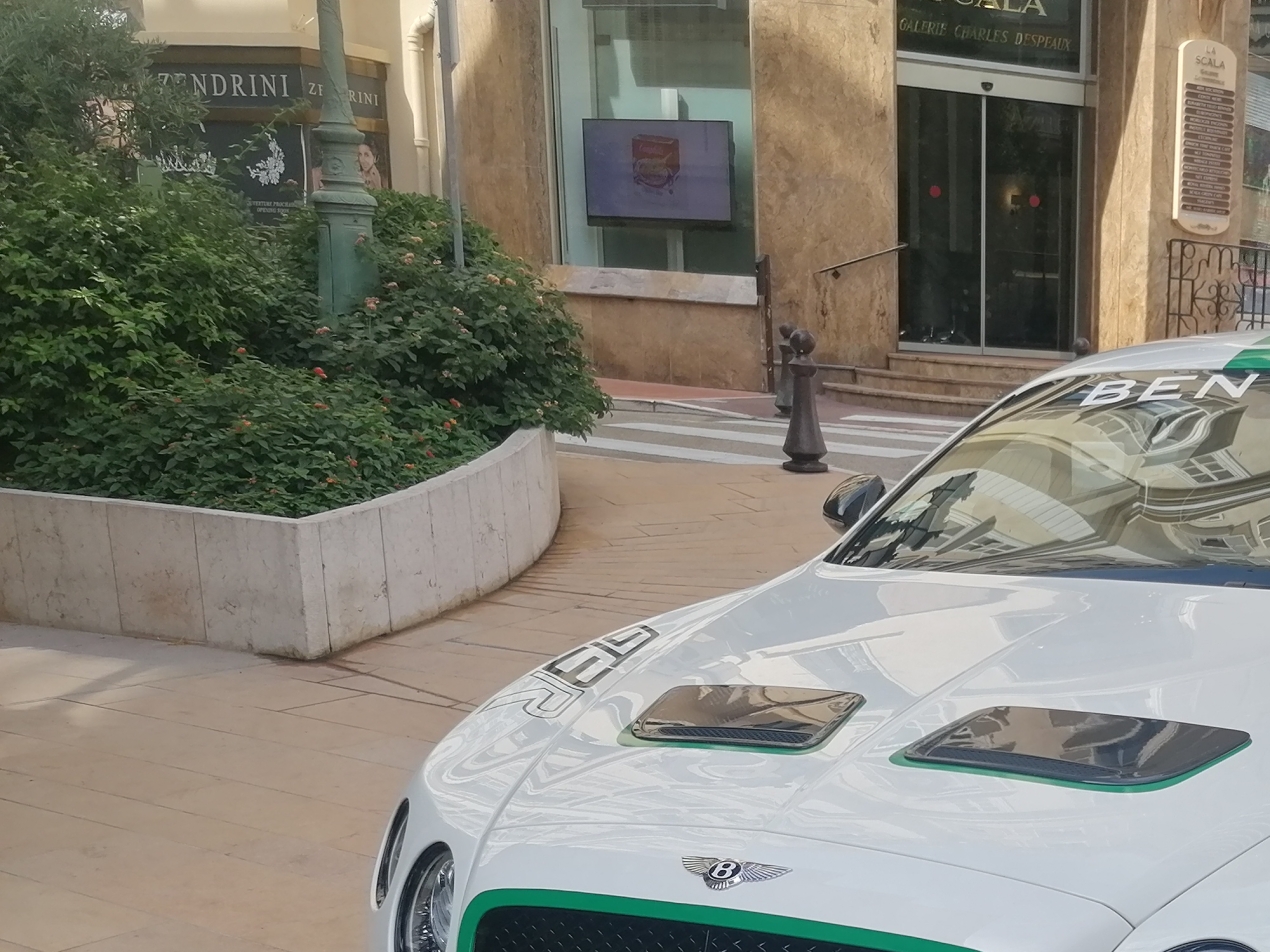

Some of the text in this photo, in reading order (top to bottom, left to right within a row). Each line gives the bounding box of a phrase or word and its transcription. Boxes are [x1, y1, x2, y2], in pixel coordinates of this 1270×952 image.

[899, 17, 1072, 51] GALERIE CHARLES DESPEAUX
[1195, 55, 1226, 70] SCALA
